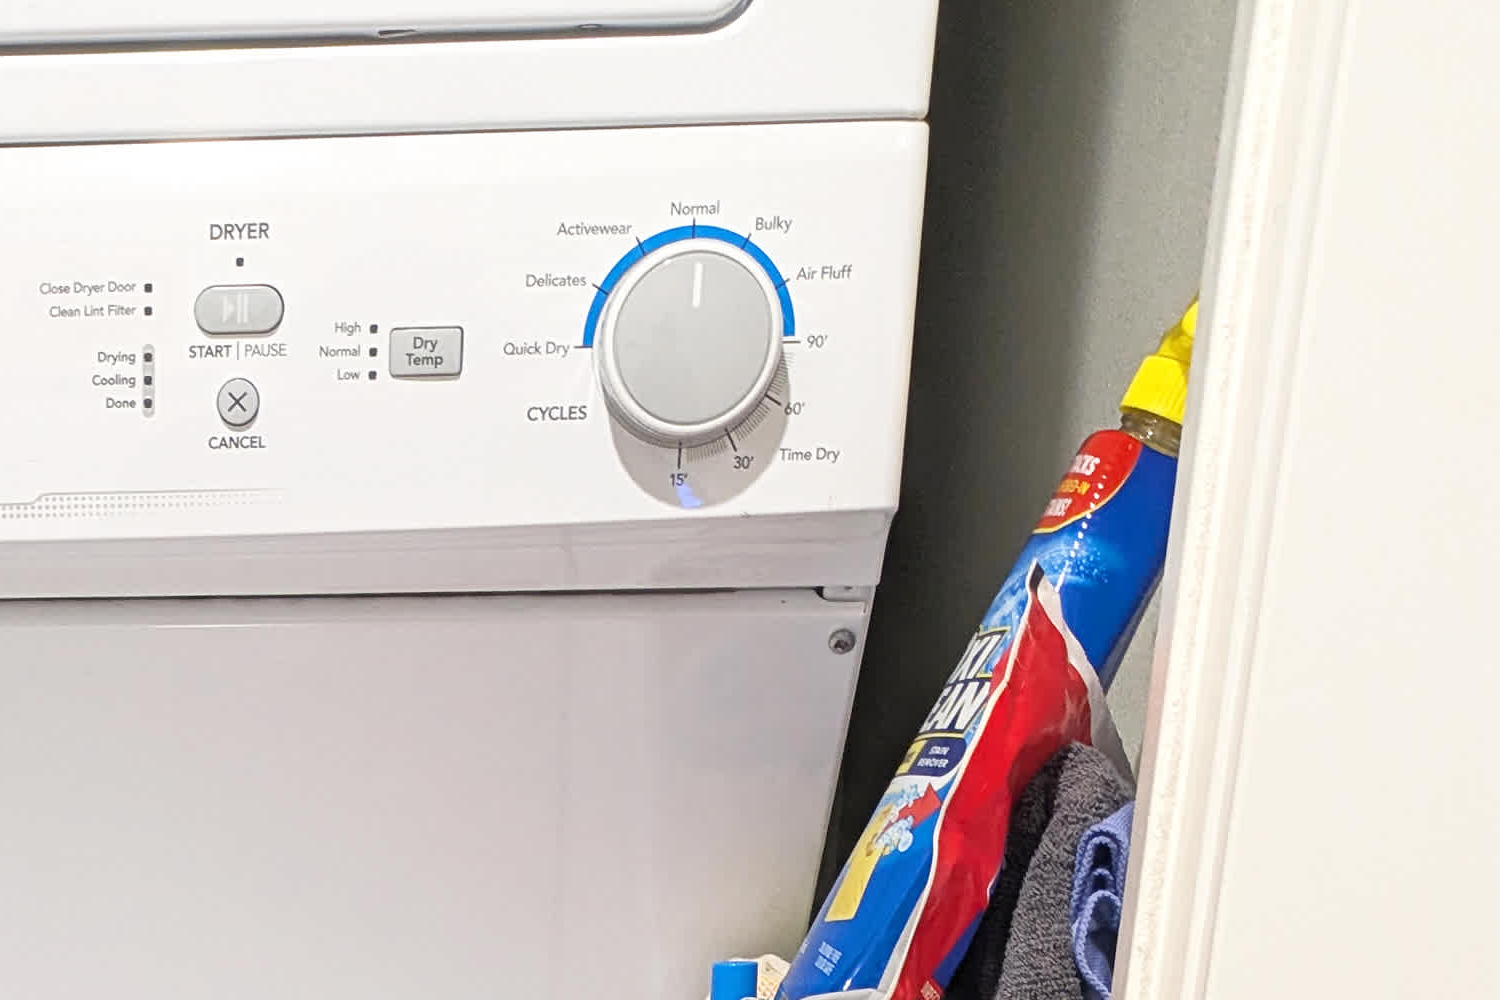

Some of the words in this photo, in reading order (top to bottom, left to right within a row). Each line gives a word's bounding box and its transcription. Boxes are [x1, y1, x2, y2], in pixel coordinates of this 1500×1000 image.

[670, 199, 720, 217] Normal
[209, 222, 270, 241] DRYER
[556, 221, 633, 236] Activewear
[755, 215, 793, 234] Bulky
[525, 272, 587, 288] Delicates
[795, 266, 818, 281] Air
[820, 263, 853, 280] Fluff
[39, 282, 71, 295] Close
[73, 281, 106, 297] Dryer
[107, 280, 137, 293] Door
[48, 305, 81, 318] Clean
[83, 304, 105, 317] Lint
[107, 304, 137, 317] Filter
[334, 321, 362, 337] High
[188, 344, 233, 359] START
[244, 342, 288, 358] PAUSE
[318, 343, 361, 358] Normal
[412, 336, 439, 353] Dry
[502, 341, 542, 356] Quick
[545, 340, 570, 359] Dry
[97, 351, 137, 366] Drying
[405, 352, 444, 369] Temp
[91, 373, 137, 389] Cooling
[337, 368, 361, 381] Low
[105, 397, 137, 409] Done
[526, 404, 588, 422] CYCLES
[208, 435, 266, 450] CANCEL
[778, 446, 813, 461] Time
[815, 447, 841, 464] Dry
